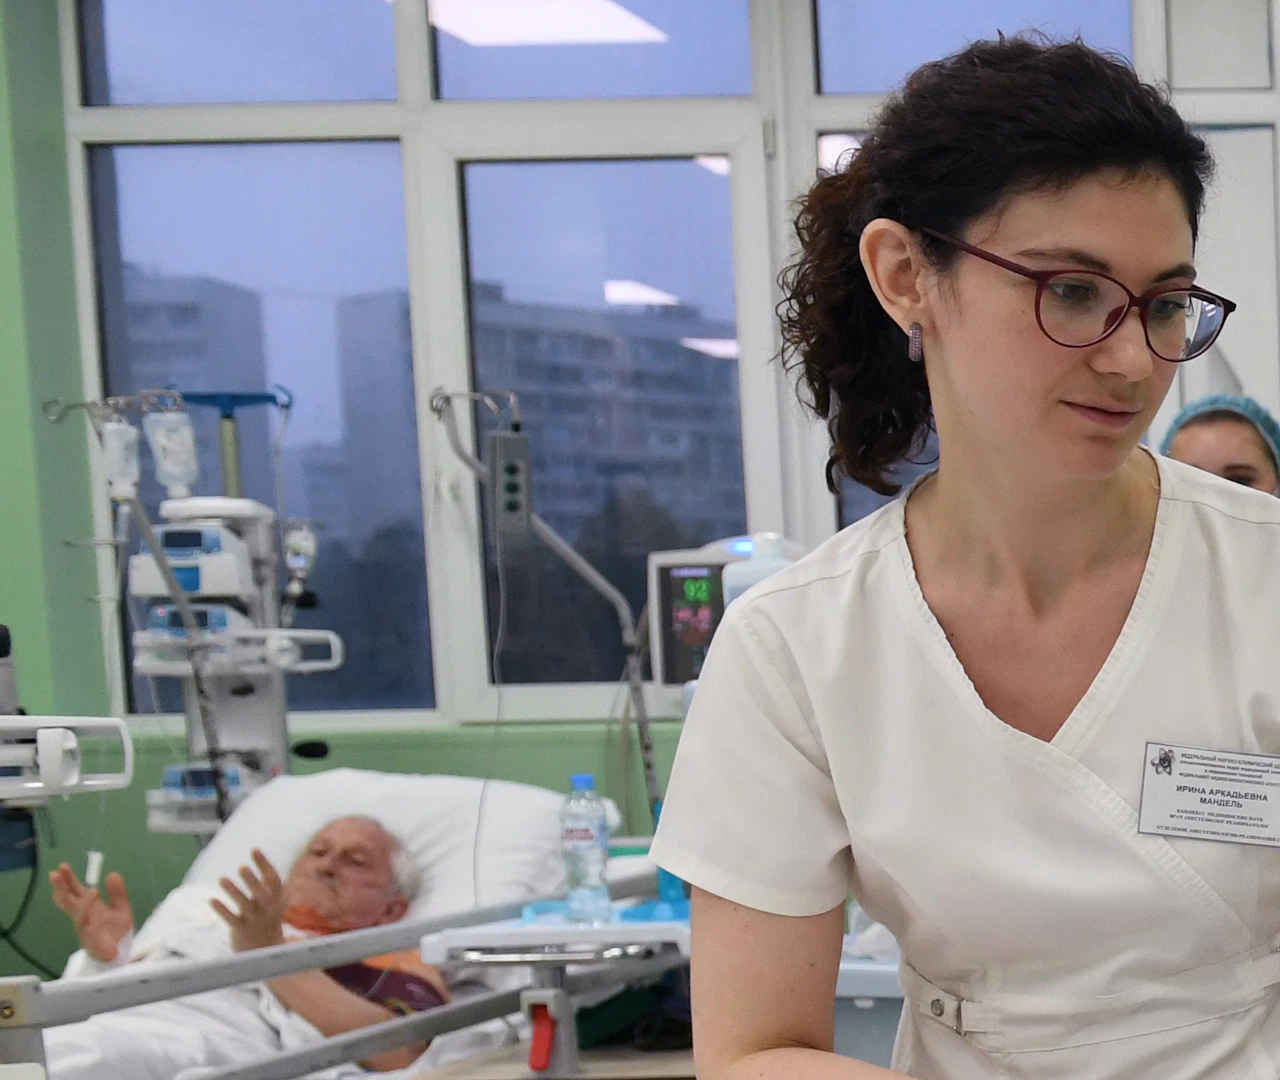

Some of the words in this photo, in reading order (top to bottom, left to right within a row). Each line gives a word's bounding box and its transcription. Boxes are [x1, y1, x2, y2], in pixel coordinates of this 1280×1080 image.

[1176, 784, 1207, 795] ИРИНА
[1208, 788, 1269, 802] АРКАДЬЕВНА
[1199, 797, 1243, 809] МАНДЕЛЬ
